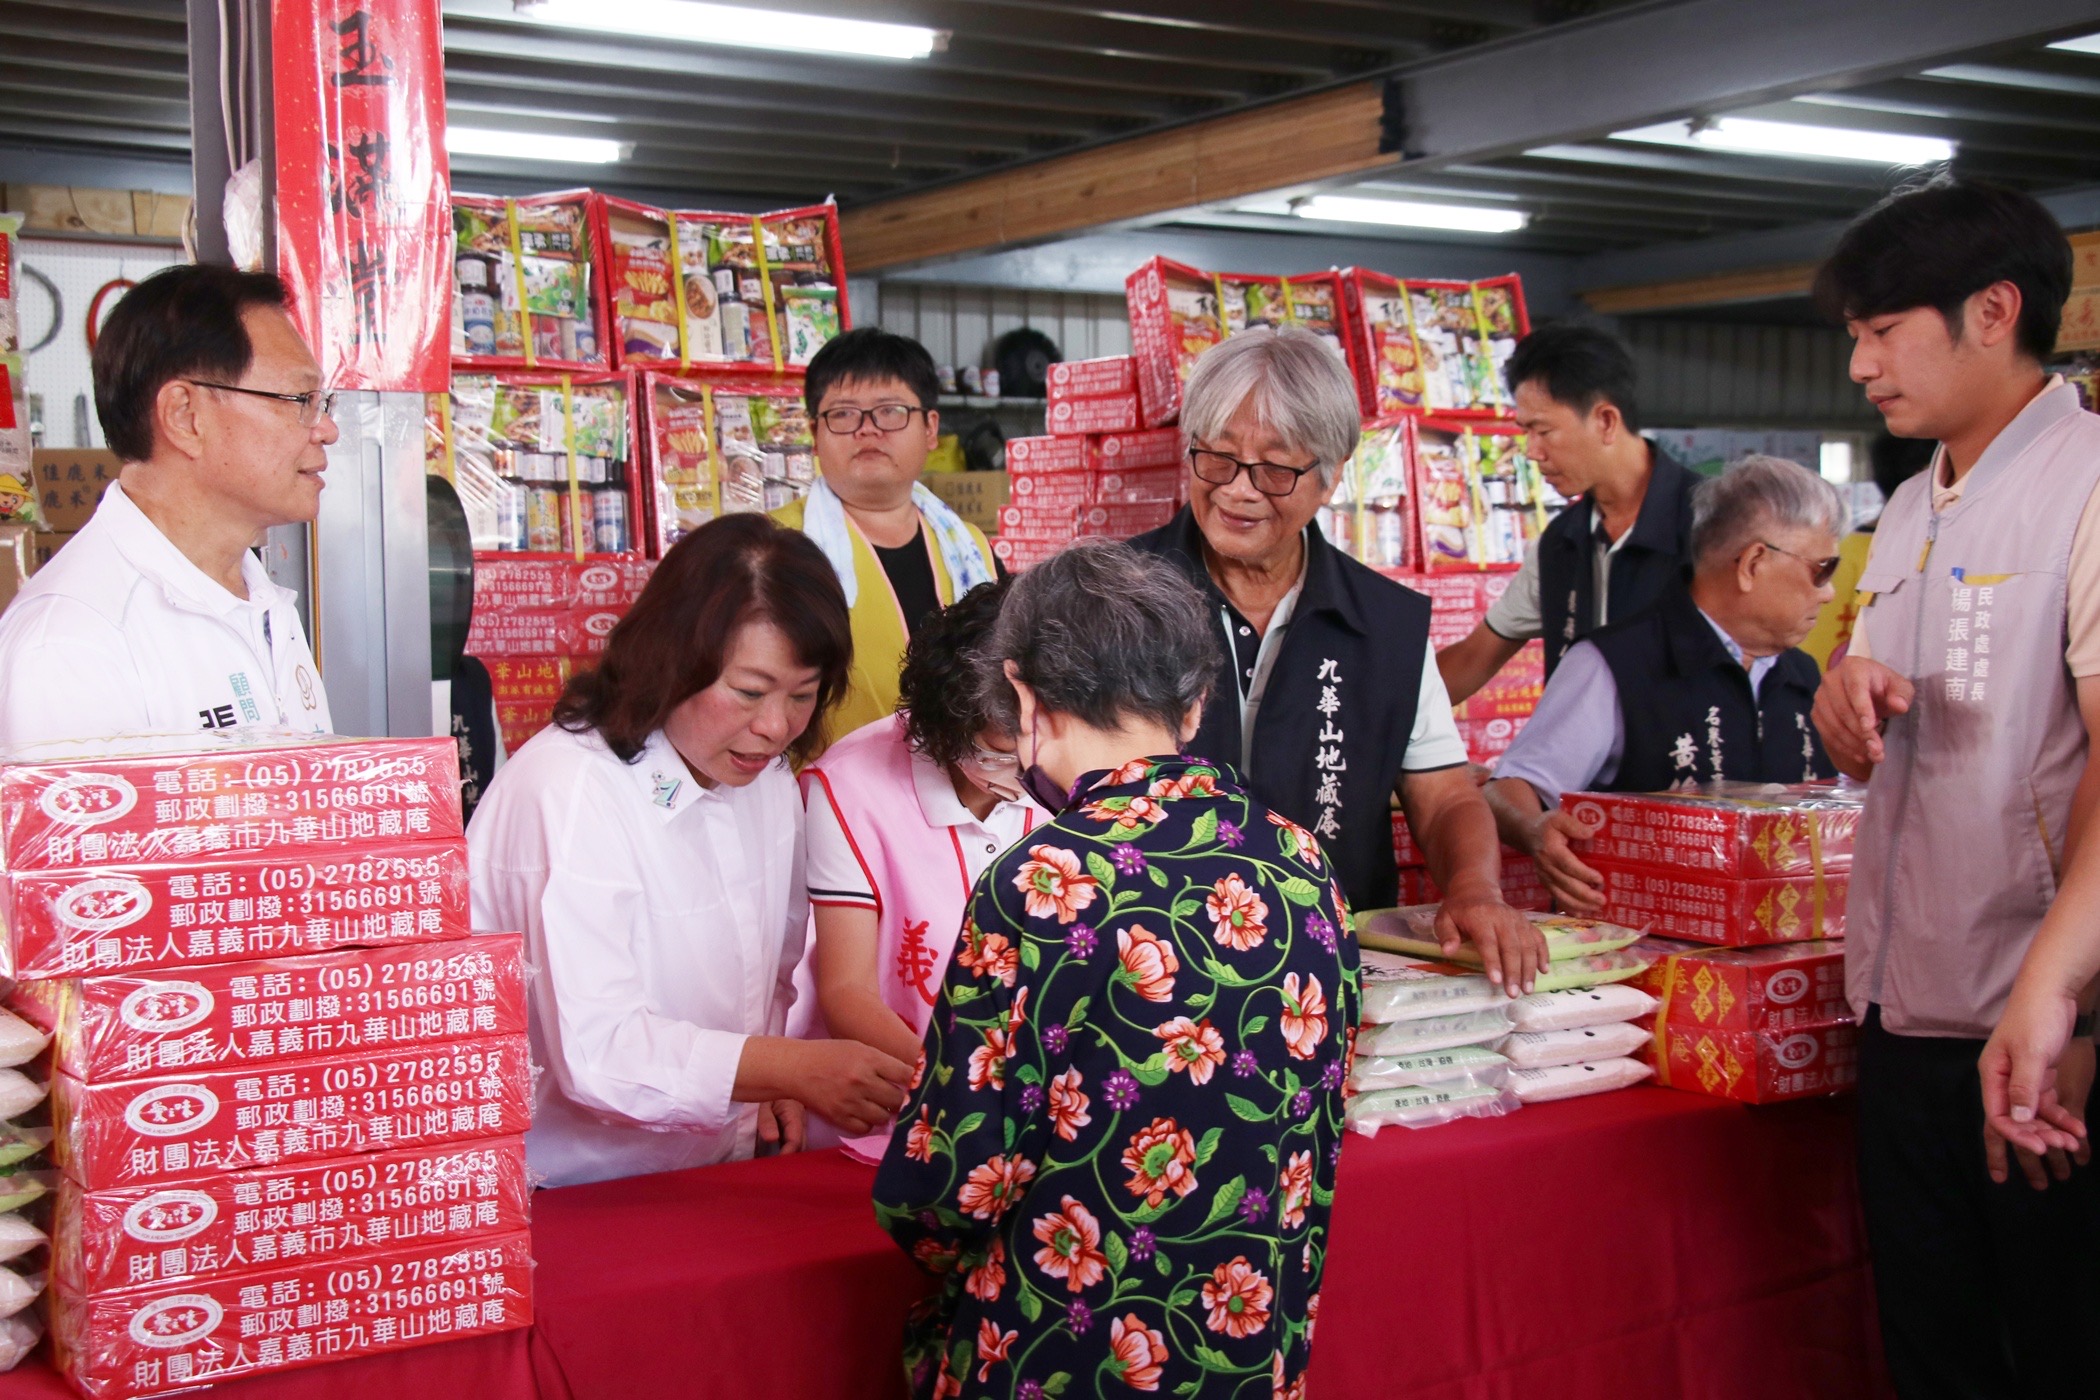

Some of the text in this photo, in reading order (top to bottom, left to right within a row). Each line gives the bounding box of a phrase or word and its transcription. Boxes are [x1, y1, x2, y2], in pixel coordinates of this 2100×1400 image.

[1945, 588, 1972, 701] 楊張建南
[1970, 586, 1994, 700] 民政處處長
[153, 755, 426, 795] 電話: (05) 2782555
[1313, 658, 1347, 839] 九華山地藏庵
[155, 781, 431, 822] 郵政劃撥:31566691號
[1645, 809, 1669, 823] (05)
[48, 808, 431, 864] 財團法人嘉義市九華山地藏庵
[169, 857, 440, 899] 電話: (05) 2782555
[170, 880, 442, 927] 郵政劃撥:31566691號
[1645, 876, 1670, 893] (05)
[1673, 882, 1725, 901] 2782555
[62, 908, 443, 969] 財團法人嘉義市九華山地藏庵
[230, 956, 494, 999] 電話: (05) 2782555
[231, 980, 496, 1028] 郵政劃撥:31566691號
[126, 1005, 498, 1070] 財團法人嘉義市九華山地藏庵
[234, 1053, 500, 1101] 電話: (05) 2782555
[236, 1079, 502, 1129] 郵政劃撥:31566691號
[132, 1102, 502, 1176] 財團法人嘉義市九華山地藏庵
[148, 1100, 194, 1122] 愛之味
[234, 1150, 498, 1206] 電話: (05) 2782555
[235, 1177, 499, 1235] 郵政劃撥:31566691號
[129, 1200, 499, 1282] 財團法人嘉義市九華山地藏庵
[240, 1248, 503, 1309] 電話: (05) 2782555
[240, 1275, 504, 1338] 郵政劃撥:31566691號
[135, 1301, 505, 1388] 財團法人嘉義市九華山地藏庵
